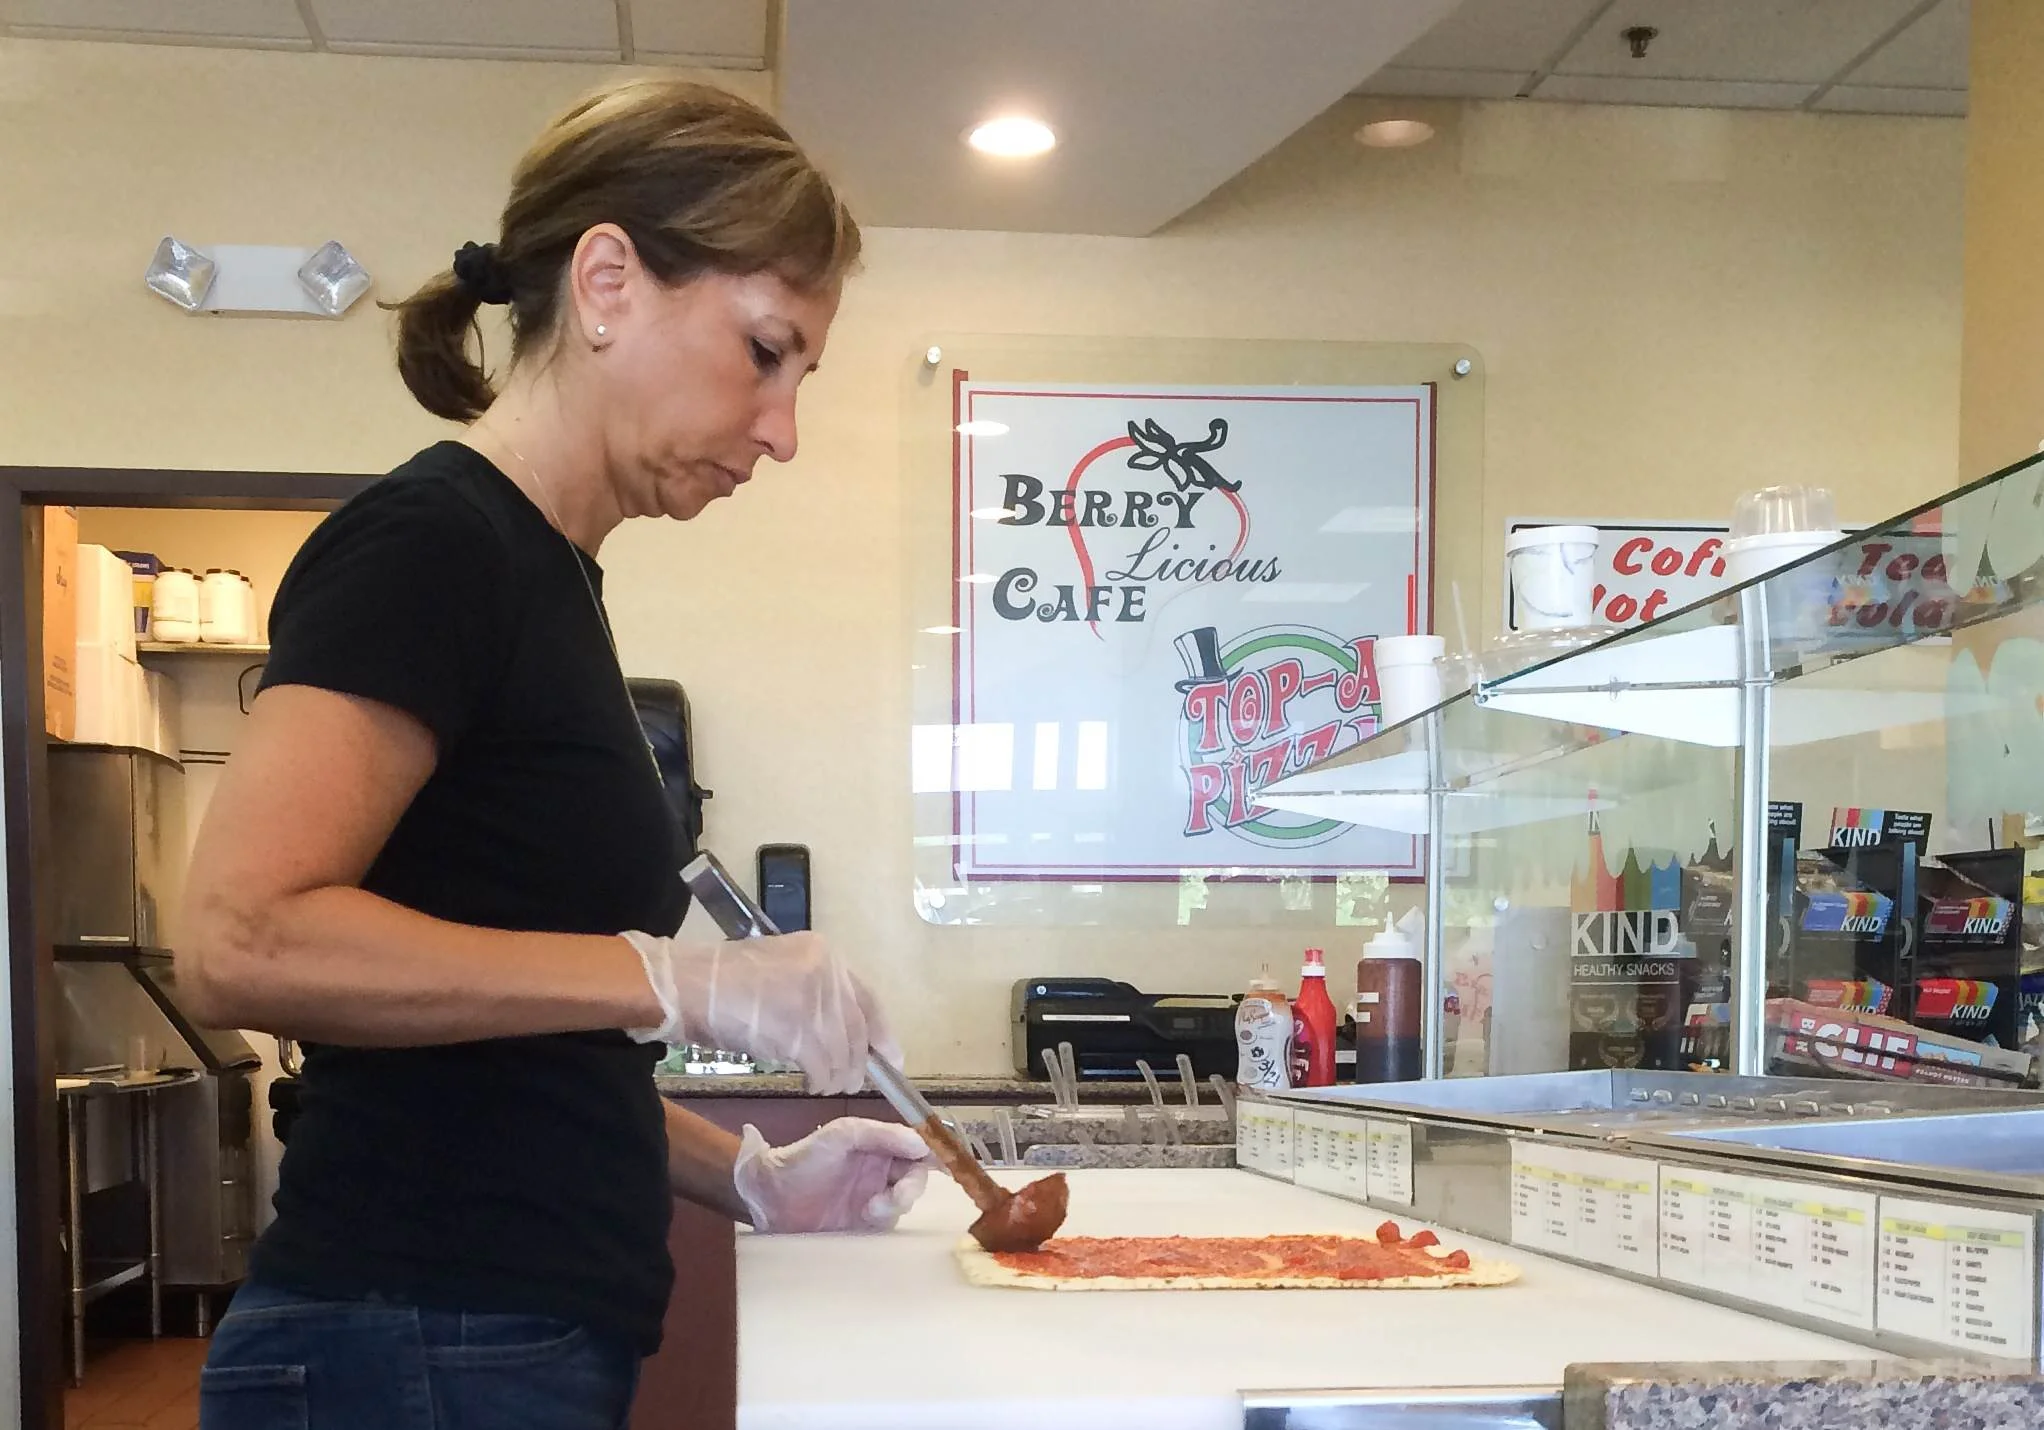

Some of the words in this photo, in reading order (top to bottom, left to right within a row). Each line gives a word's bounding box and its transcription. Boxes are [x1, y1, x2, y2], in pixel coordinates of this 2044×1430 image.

[997, 474, 1204, 529] BERRY
[1106, 526, 1282, 583] Licious
[1612, 537, 1727, 577] Cof
[992, 567, 1147, 623] CAFE
[1593, 584, 1669, 623] ot
[1831, 827, 1882, 848] KIND
[1571, 911, 1680, 956] KIND
[1840, 916, 1883, 932] KIND
[1963, 917, 2004, 934] KIND
[1574, 964, 1622, 977] HEALTHY
[1626, 963, 1675, 977] SNACKS
[1950, 1004, 1992, 1019] KIND
[1814, 1022, 1911, 1072] CLIF
